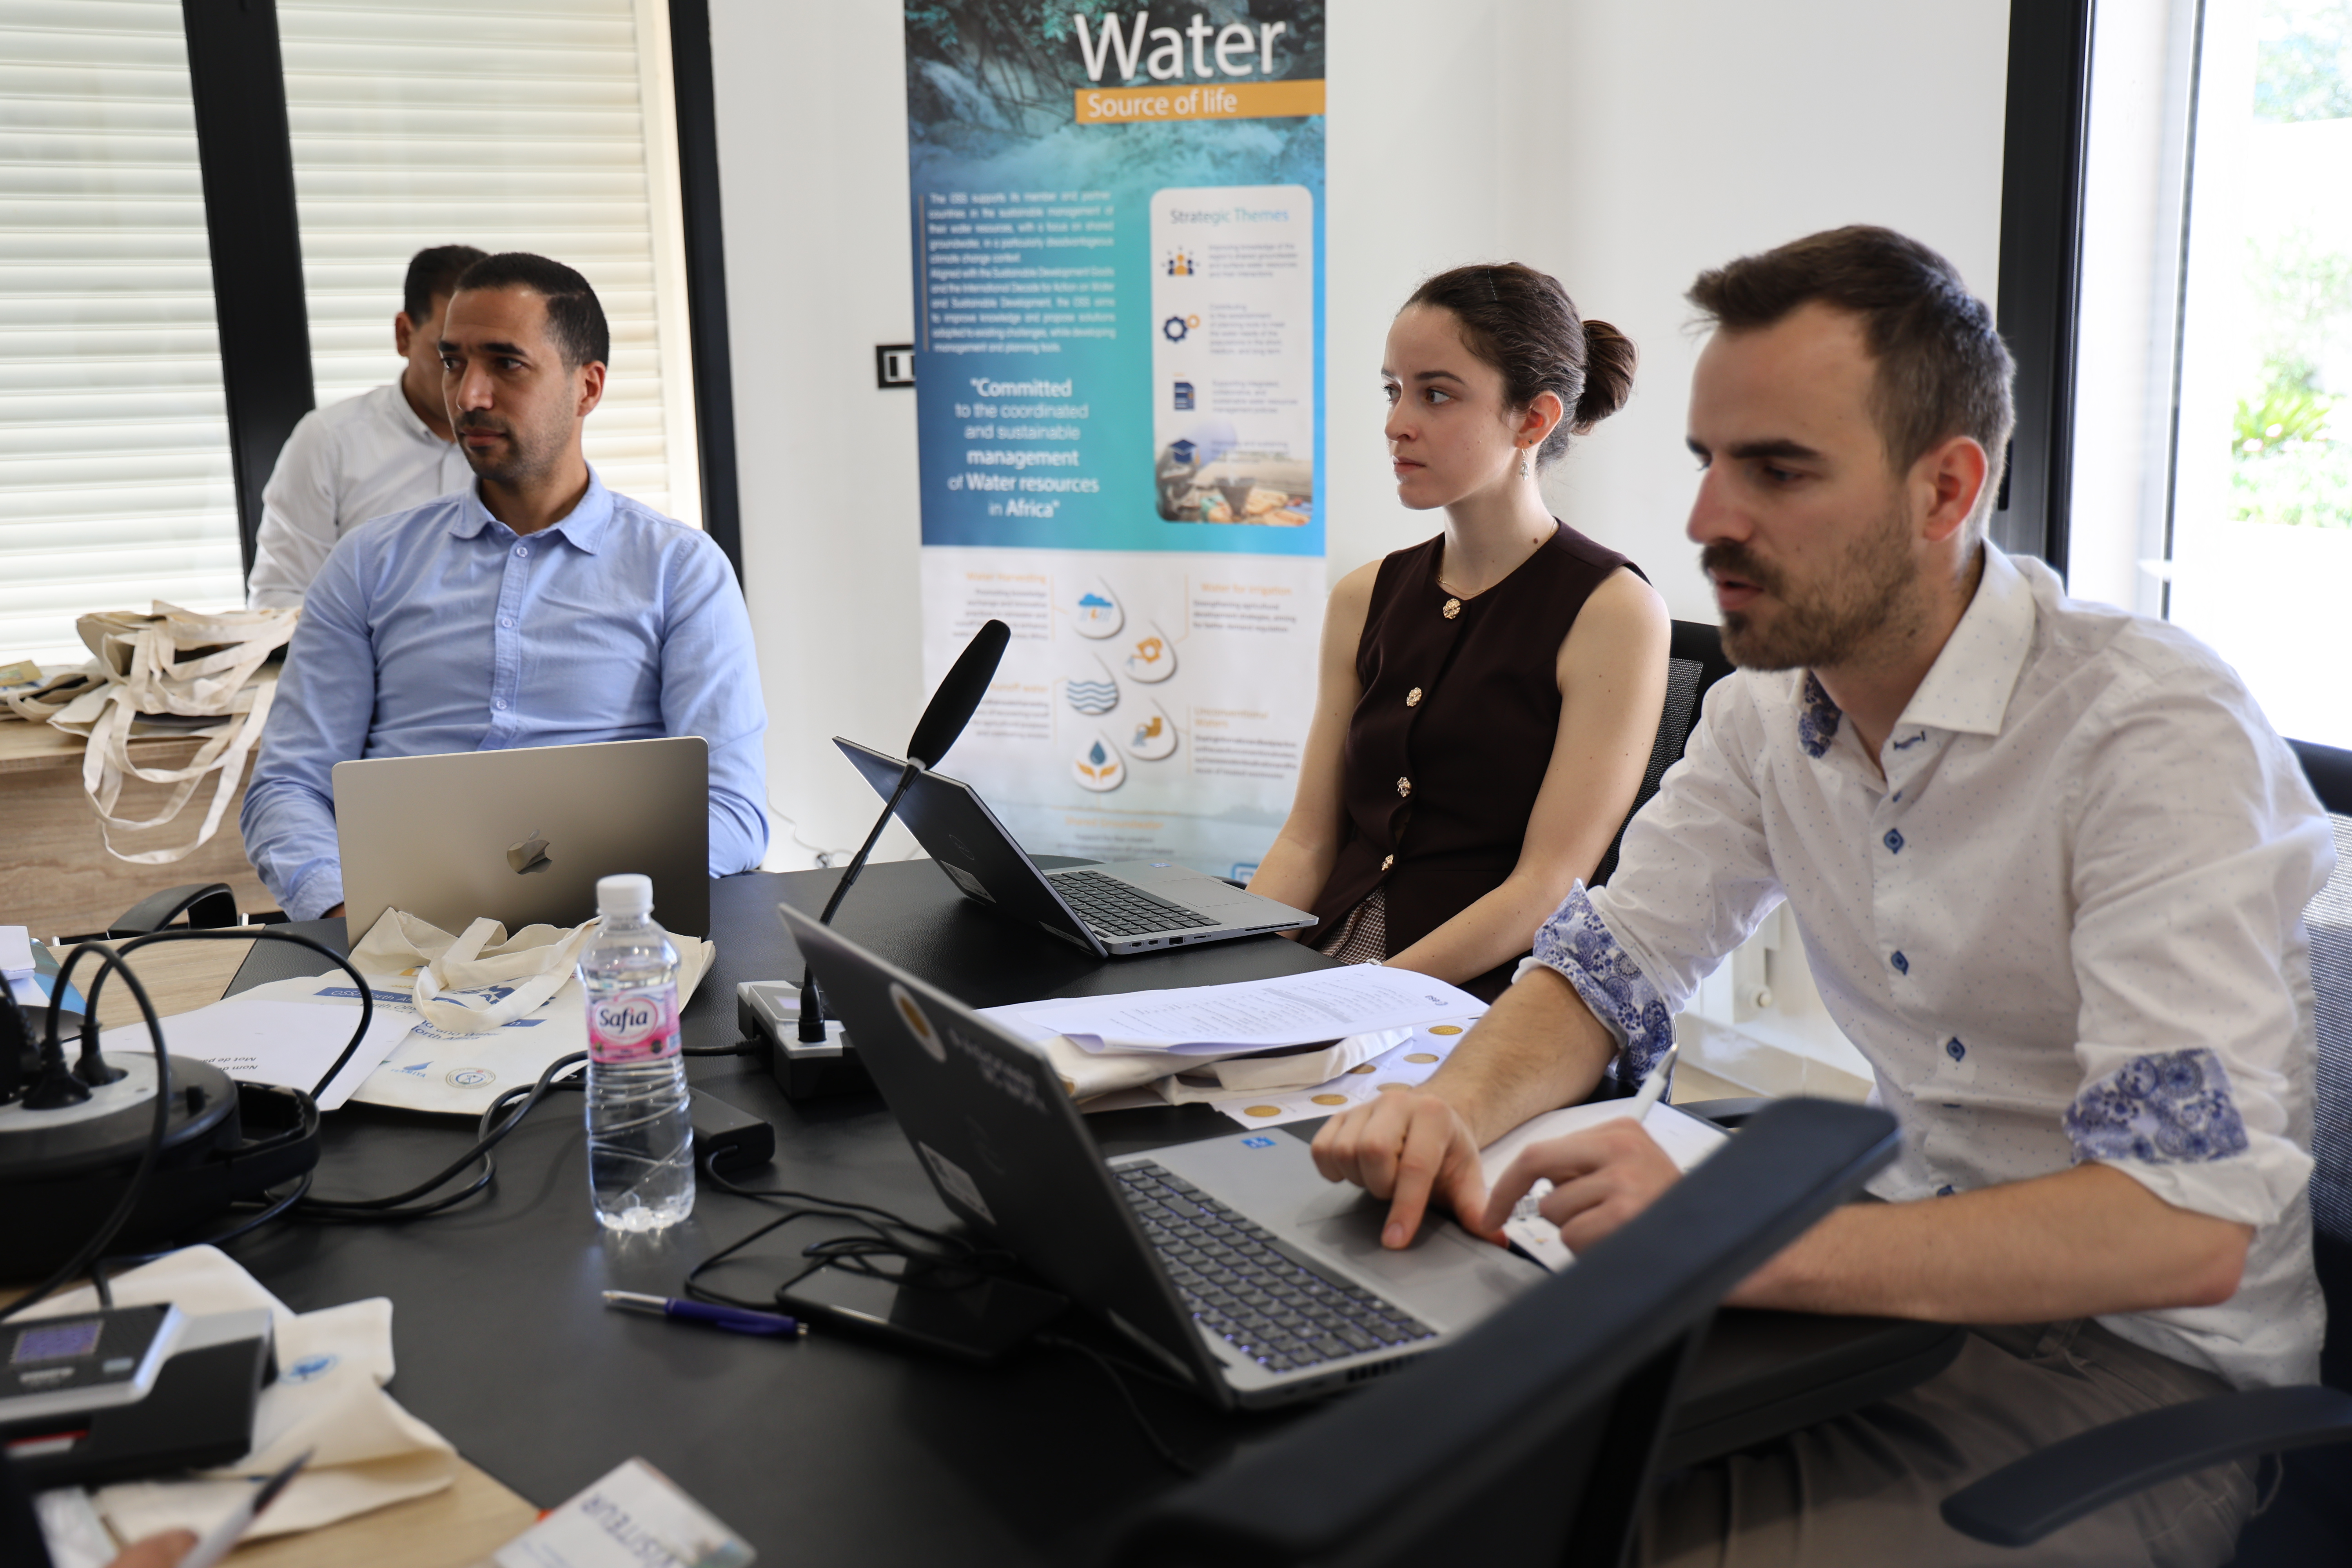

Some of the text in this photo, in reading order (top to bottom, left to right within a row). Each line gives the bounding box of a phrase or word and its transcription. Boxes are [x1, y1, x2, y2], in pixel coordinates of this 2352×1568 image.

[1074, 11, 1285, 82] Water
[1087, 87, 1238, 118] Source of life
[1170, 208, 1289, 227] Strategic Themes
[970, 377, 1073, 397] "Committed
[955, 402, 1089, 419] to the coordinated
[964, 423, 1080, 440] and sustainable
[966, 449, 1079, 470] management
[947, 472, 1100, 493] of Water resources
[988, 497, 1060, 518] in Africa"
[599, 1007, 648, 1034] Safia
